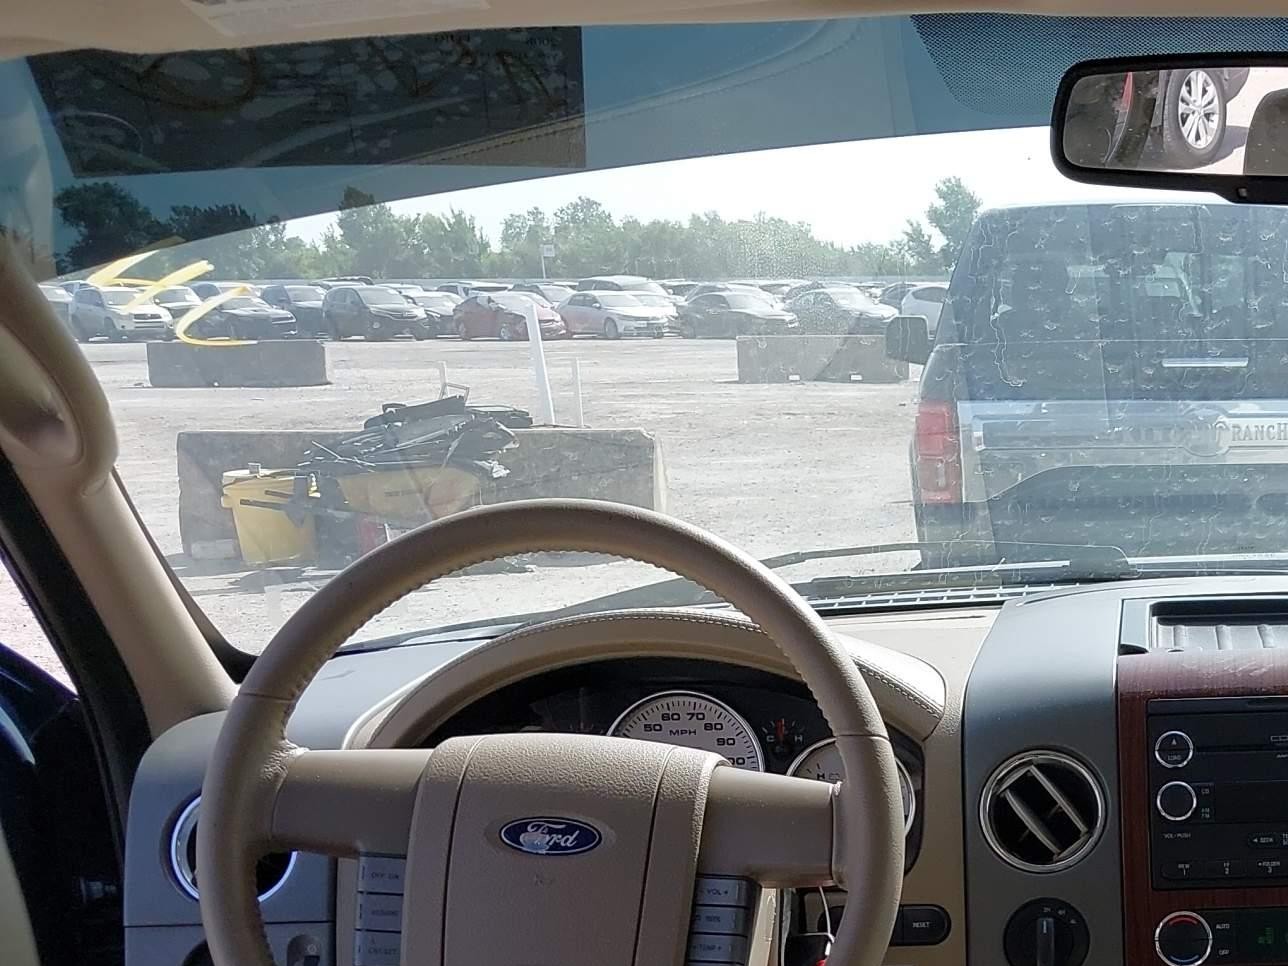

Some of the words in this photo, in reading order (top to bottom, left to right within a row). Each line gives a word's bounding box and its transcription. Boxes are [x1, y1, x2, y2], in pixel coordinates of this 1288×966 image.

[1231, 422, 1288, 441] RANCH
[661, 712, 681, 722] 60
[686, 712, 706, 721] 70
[643, 723, 663, 733] 50
[703, 722, 724, 731] 80
[668, 728, 697, 737] MPH
[716, 737, 736, 746] 90
[521, 821, 579, 852] Ford
